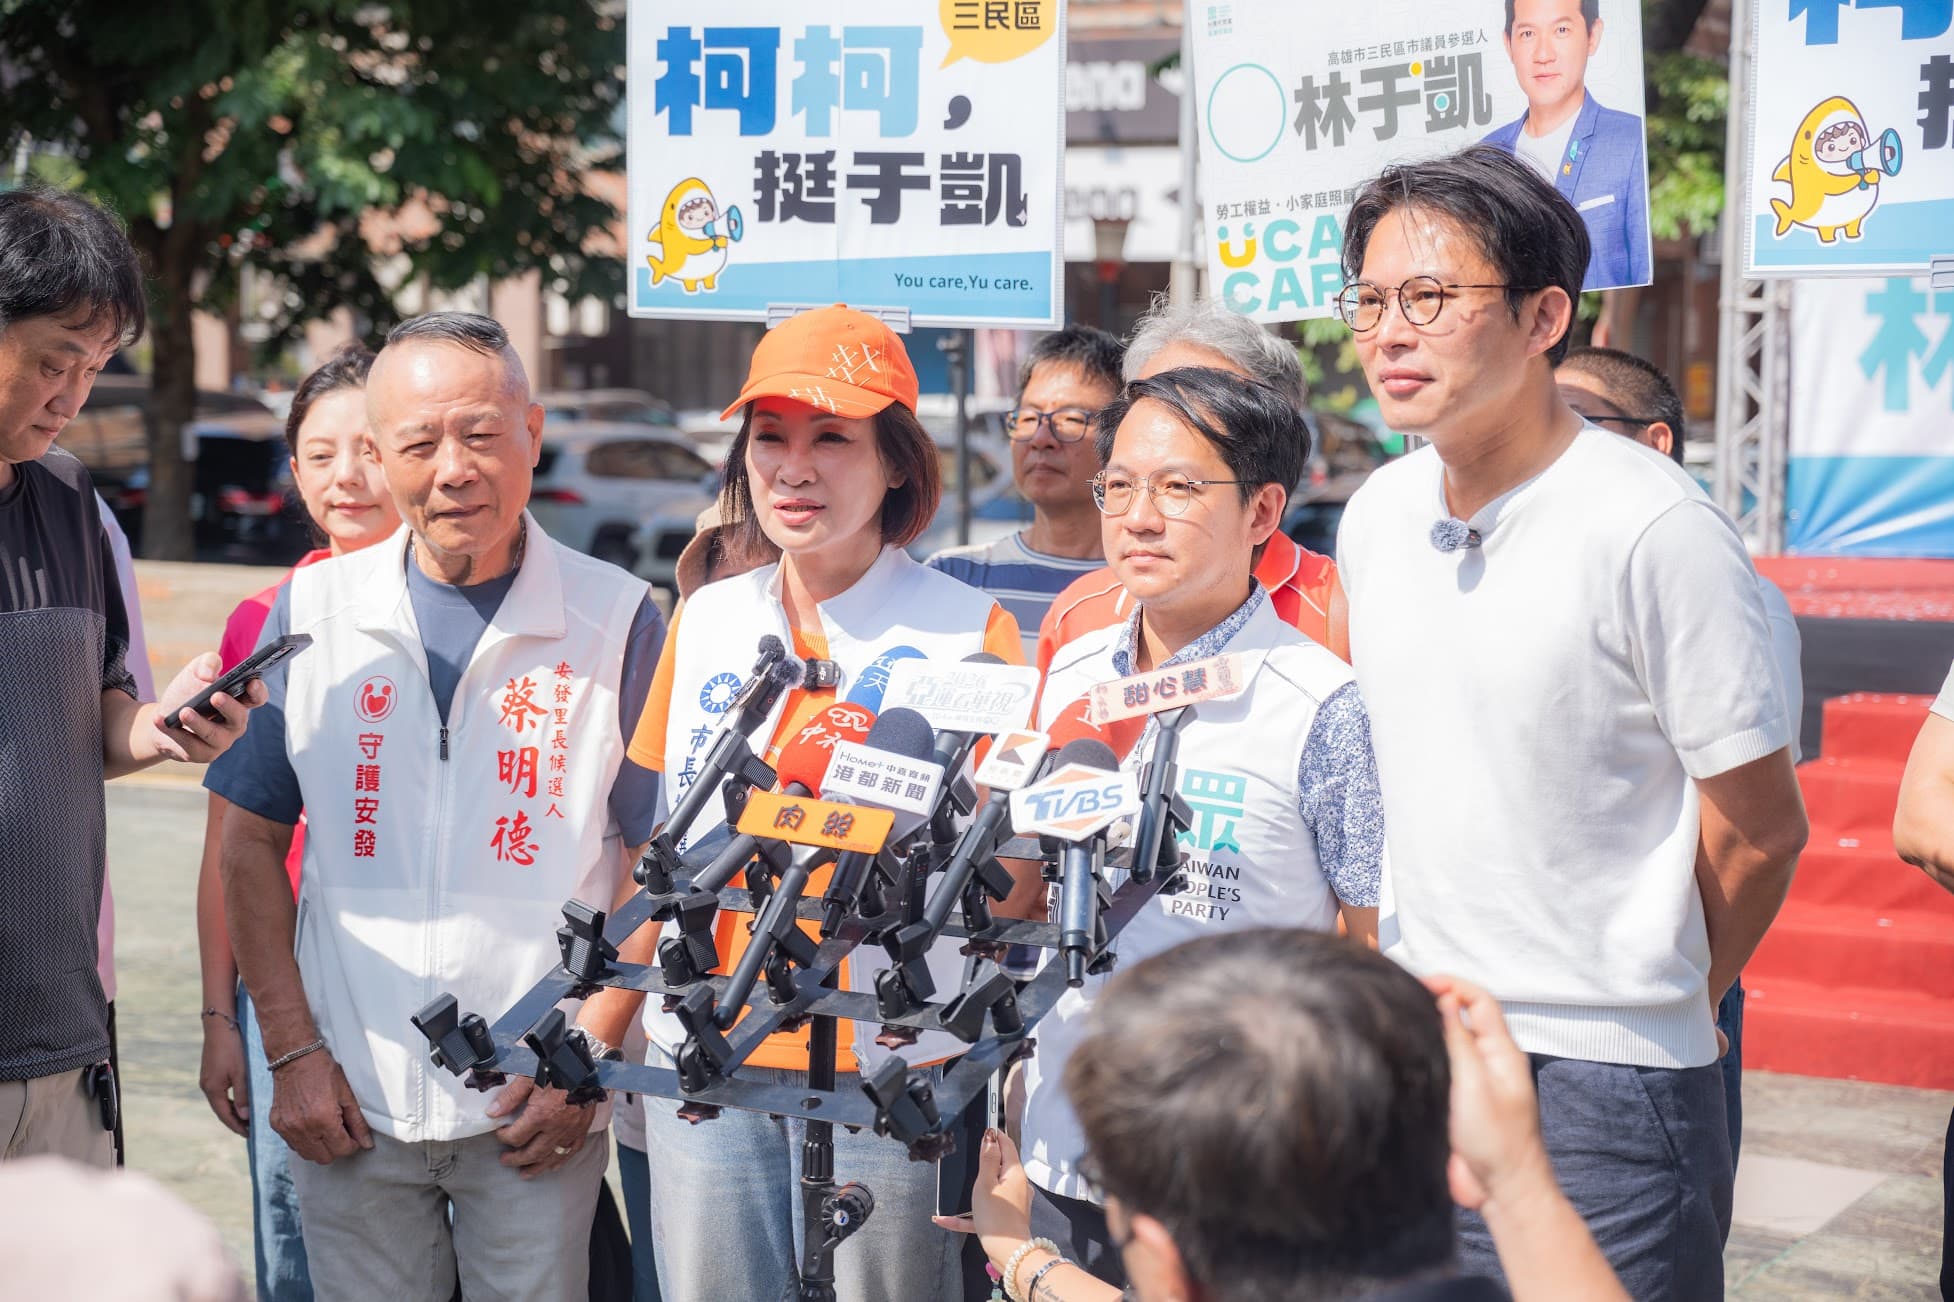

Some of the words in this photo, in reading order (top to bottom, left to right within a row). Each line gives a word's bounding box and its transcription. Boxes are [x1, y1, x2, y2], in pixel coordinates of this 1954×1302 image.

[953, 1, 1042, 31] 三民區
[1327, 28, 1489, 67] 高雄市三民區市議員參選人
[1293, 51, 1493, 151] 林于凱
[753, 150, 1028, 227] 挺于凱
[894, 273, 924, 290] You
[993, 276, 1034, 291] care.
[1122, 667, 1208, 708] 甜心慧
[544, 661, 574, 819] 安發里長候選人
[490, 675, 549, 866] 蔡明德
[833, 764, 928, 802] 港都新聞
[353, 732, 385, 858] 守護安發
[1025, 784, 1123, 822] TVBS
[1179, 860, 1240, 881] AIWAN
[1171, 899, 1230, 921] PARTY
[1185, 880, 1241, 902] OPLE'S
